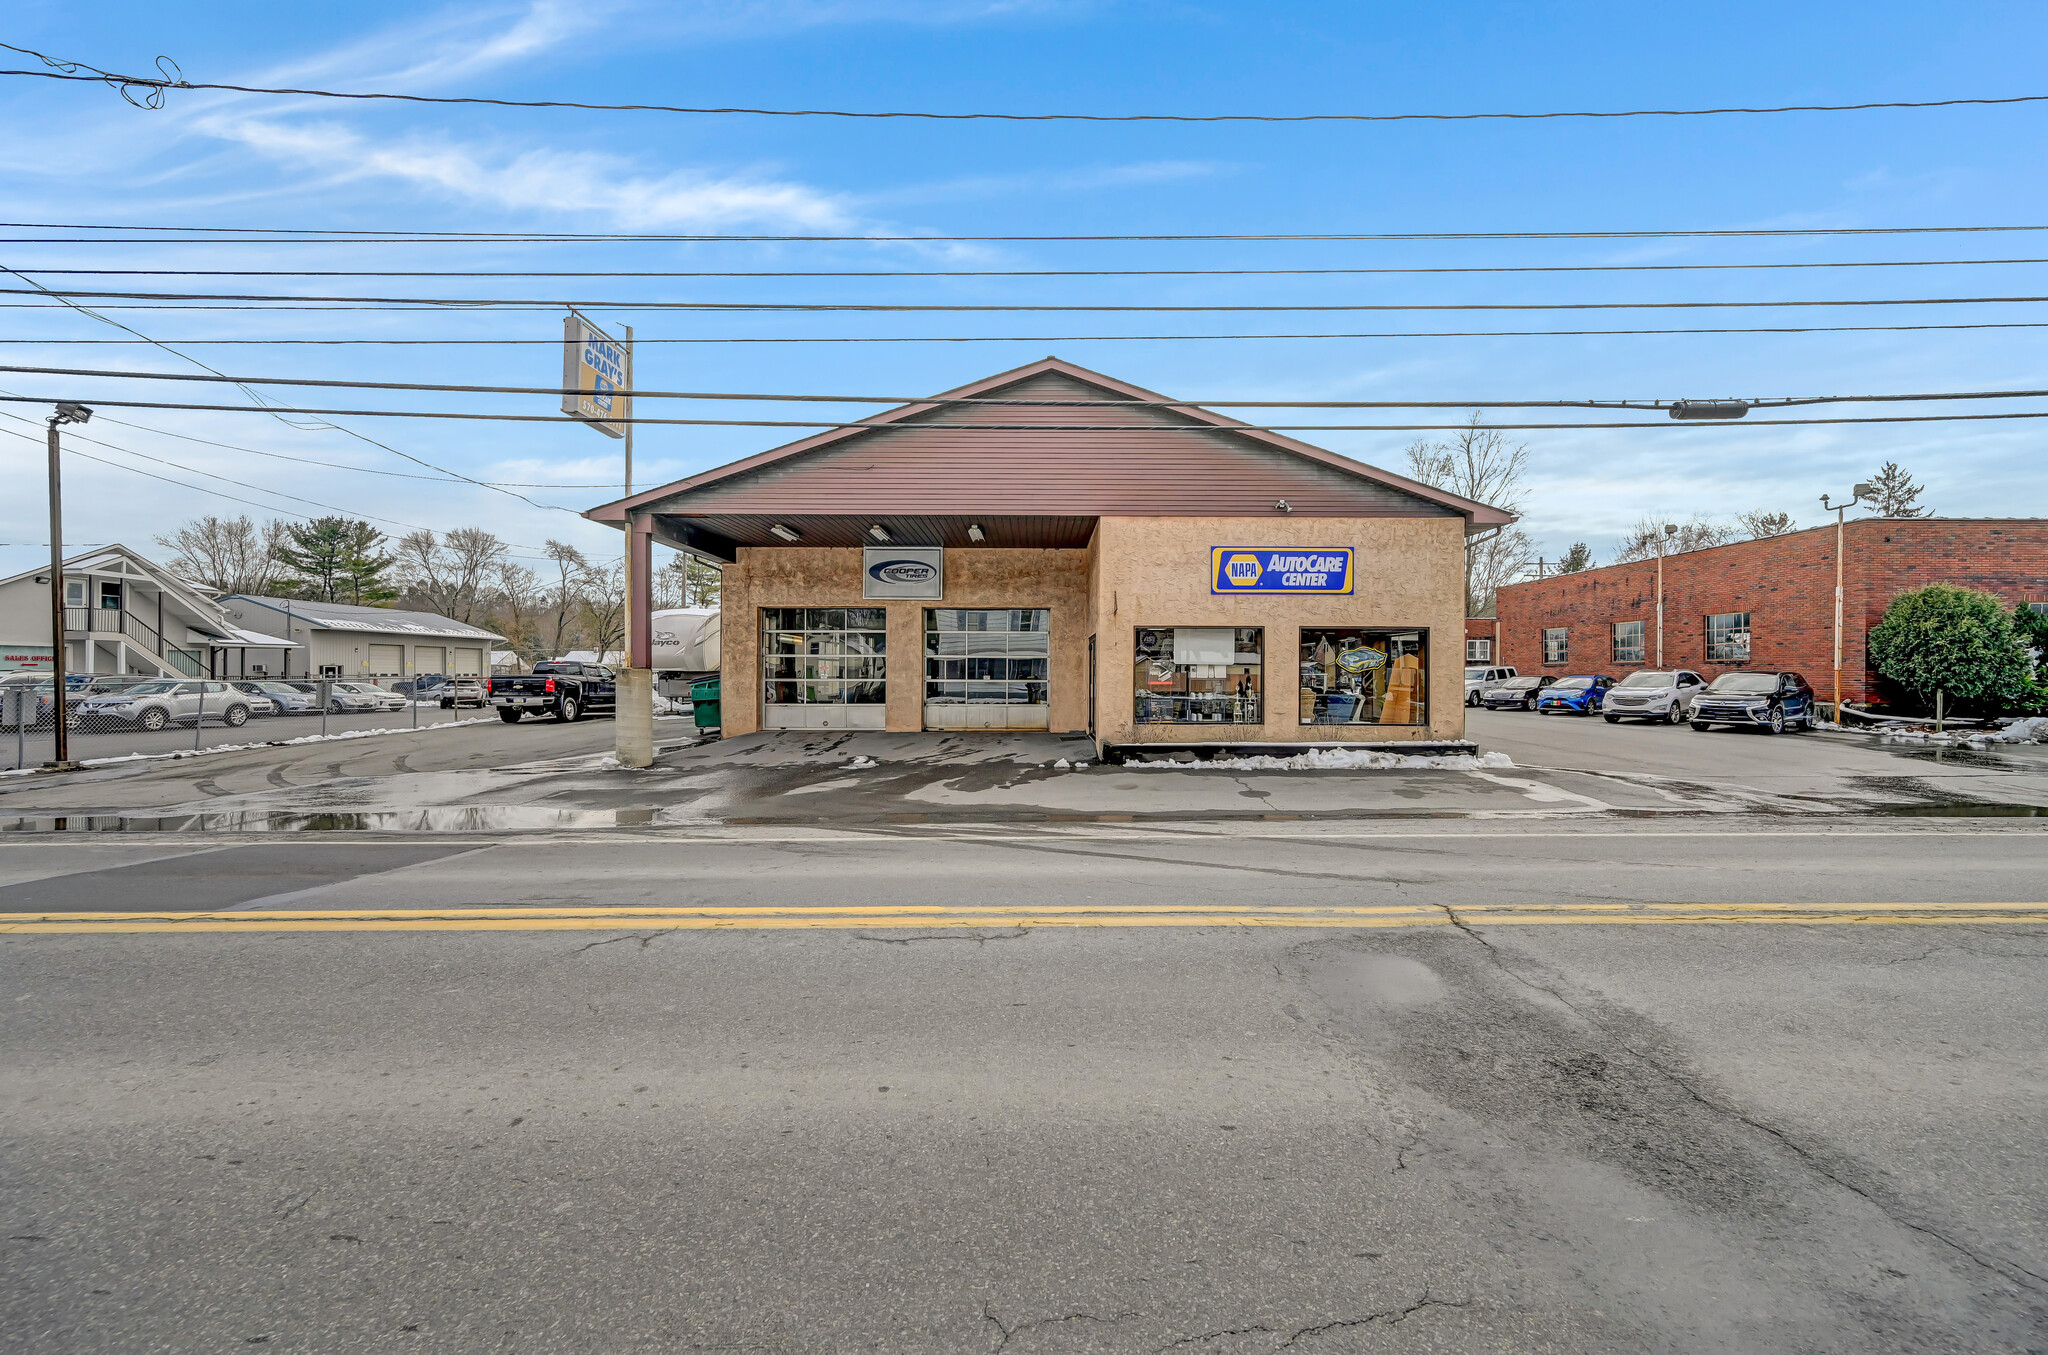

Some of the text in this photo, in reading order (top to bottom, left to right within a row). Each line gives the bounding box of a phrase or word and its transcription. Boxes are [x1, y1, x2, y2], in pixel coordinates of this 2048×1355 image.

[588, 332, 621, 369] MARK
[585, 349, 623, 386] GRAY'S
[1231, 554, 1344, 577] NAPA AUTOCARE
[1281, 573, 1328, 586] CENTER
